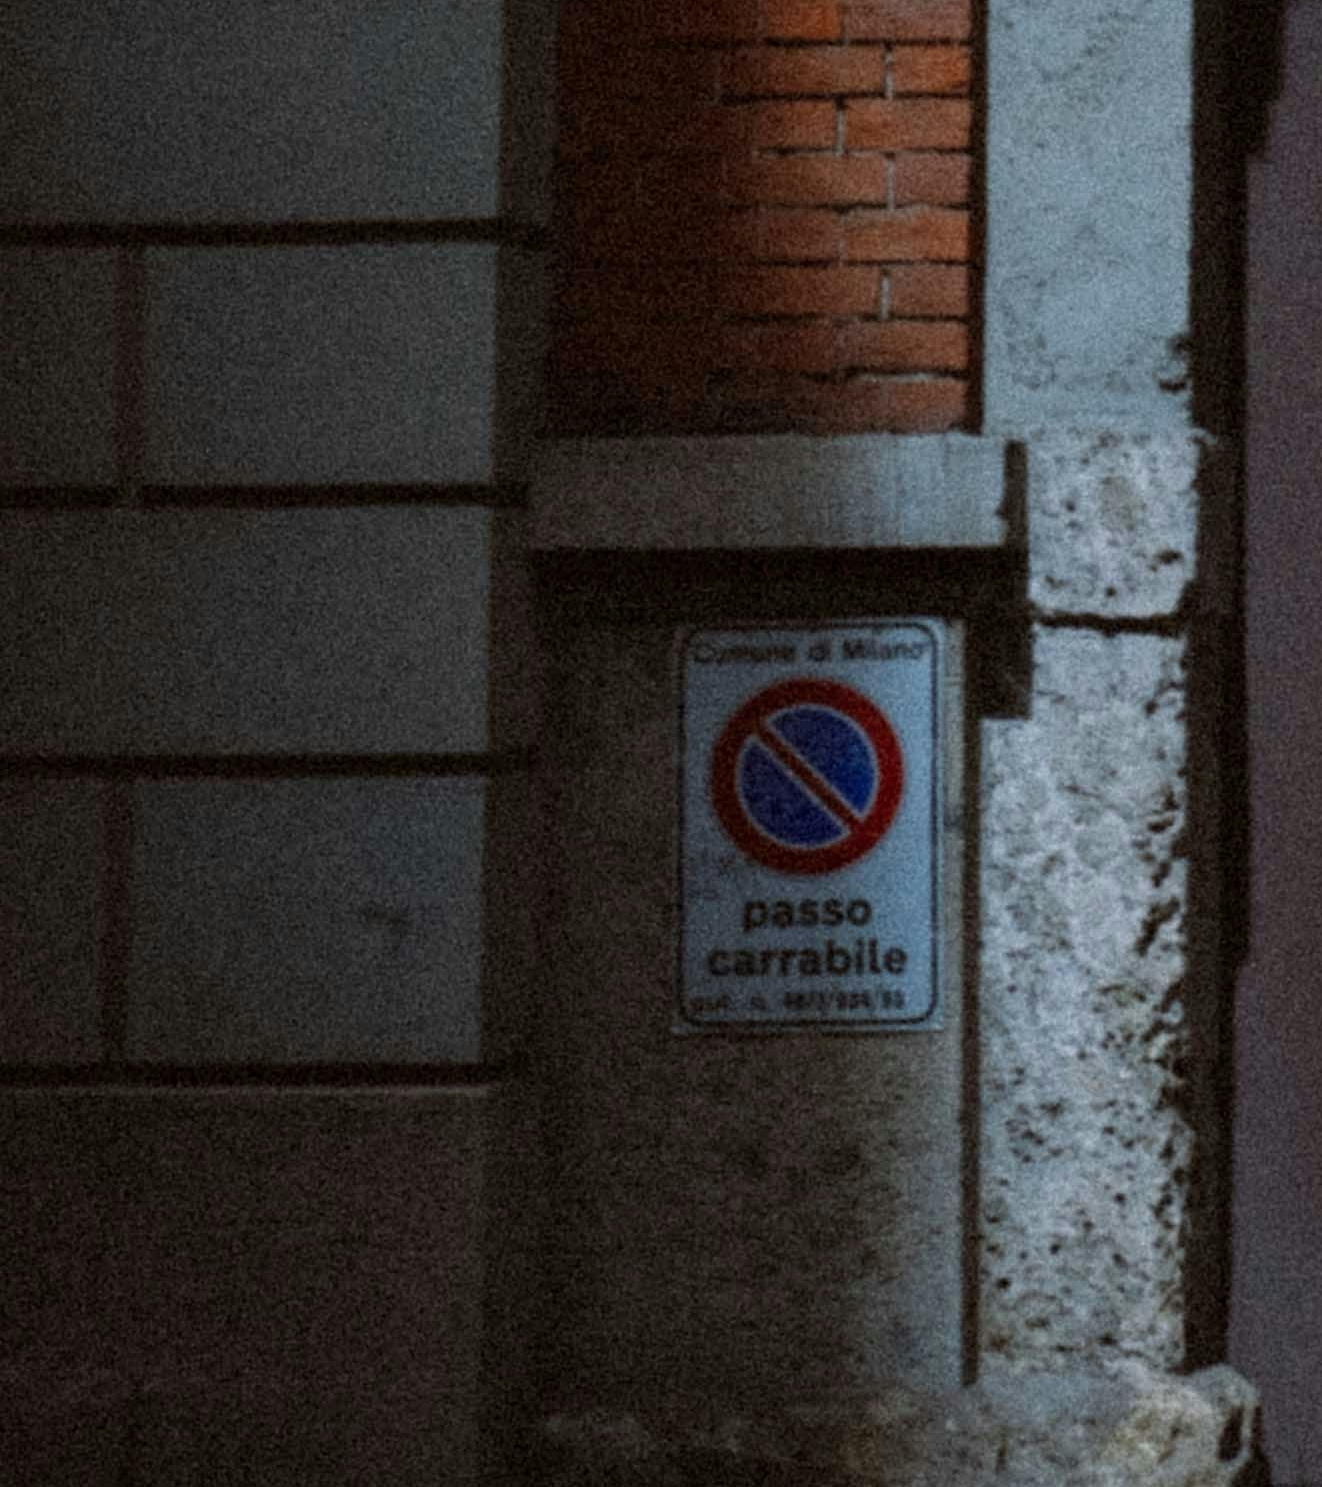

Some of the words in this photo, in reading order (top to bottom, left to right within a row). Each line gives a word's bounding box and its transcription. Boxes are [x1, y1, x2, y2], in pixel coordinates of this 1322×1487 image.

[693, 640, 796, 665] Comune
[806, 639, 832, 663] di
[841, 638, 928, 663] Milano
[742, 897, 873, 933] passo
[707, 937, 909, 977] carrabile
